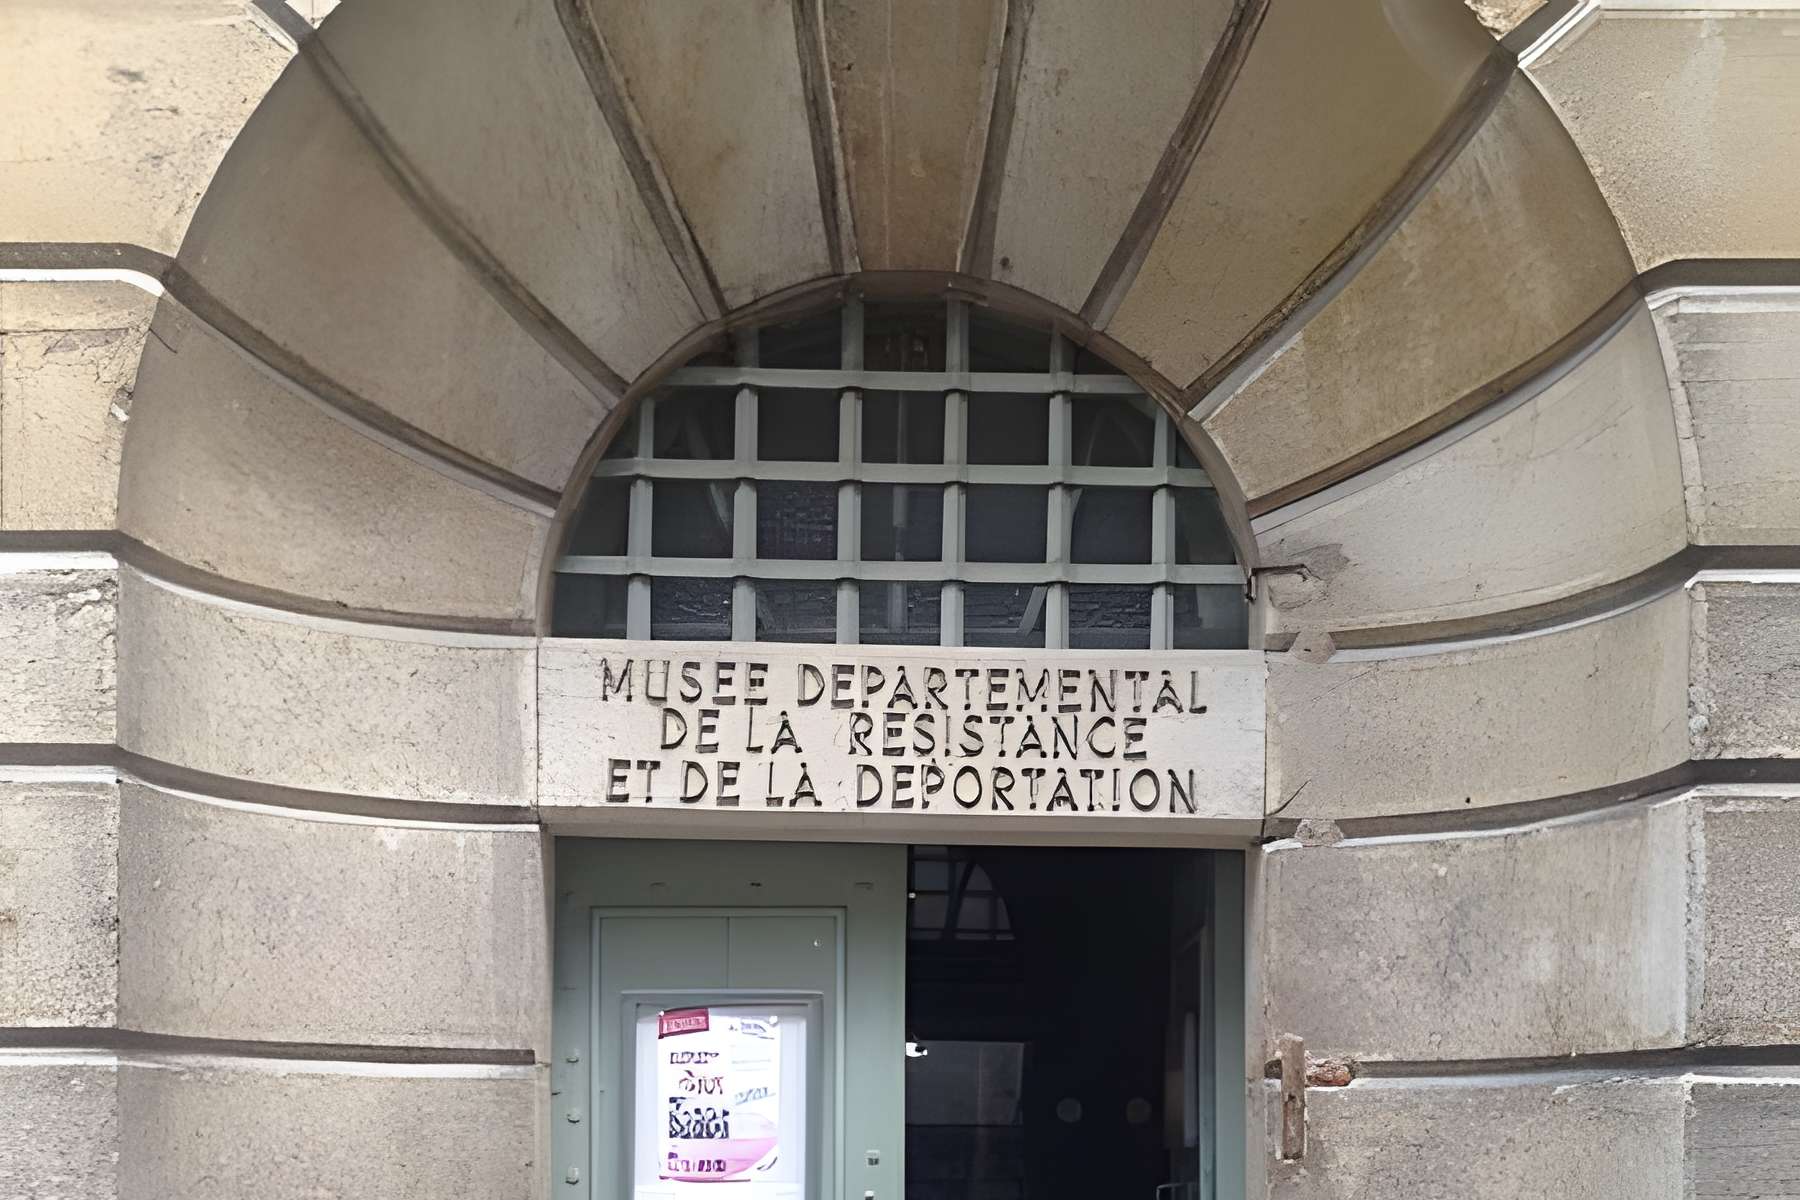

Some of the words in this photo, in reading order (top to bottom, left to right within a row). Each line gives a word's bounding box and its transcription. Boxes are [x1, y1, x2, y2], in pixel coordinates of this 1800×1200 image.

[600, 658, 768, 706] MUSEE
[797, 663, 1207, 714] DEPARTEMENTAL
[660, 706, 720, 751] DE
[746, 707, 802, 754] LA
[848, 712, 1148, 760] RESISTANCE
[607, 758, 661, 803] ET
[680, 760, 740, 805] DE
[766, 761, 822, 807] LA
[856, 764, 1199, 814] DEPORTATION
